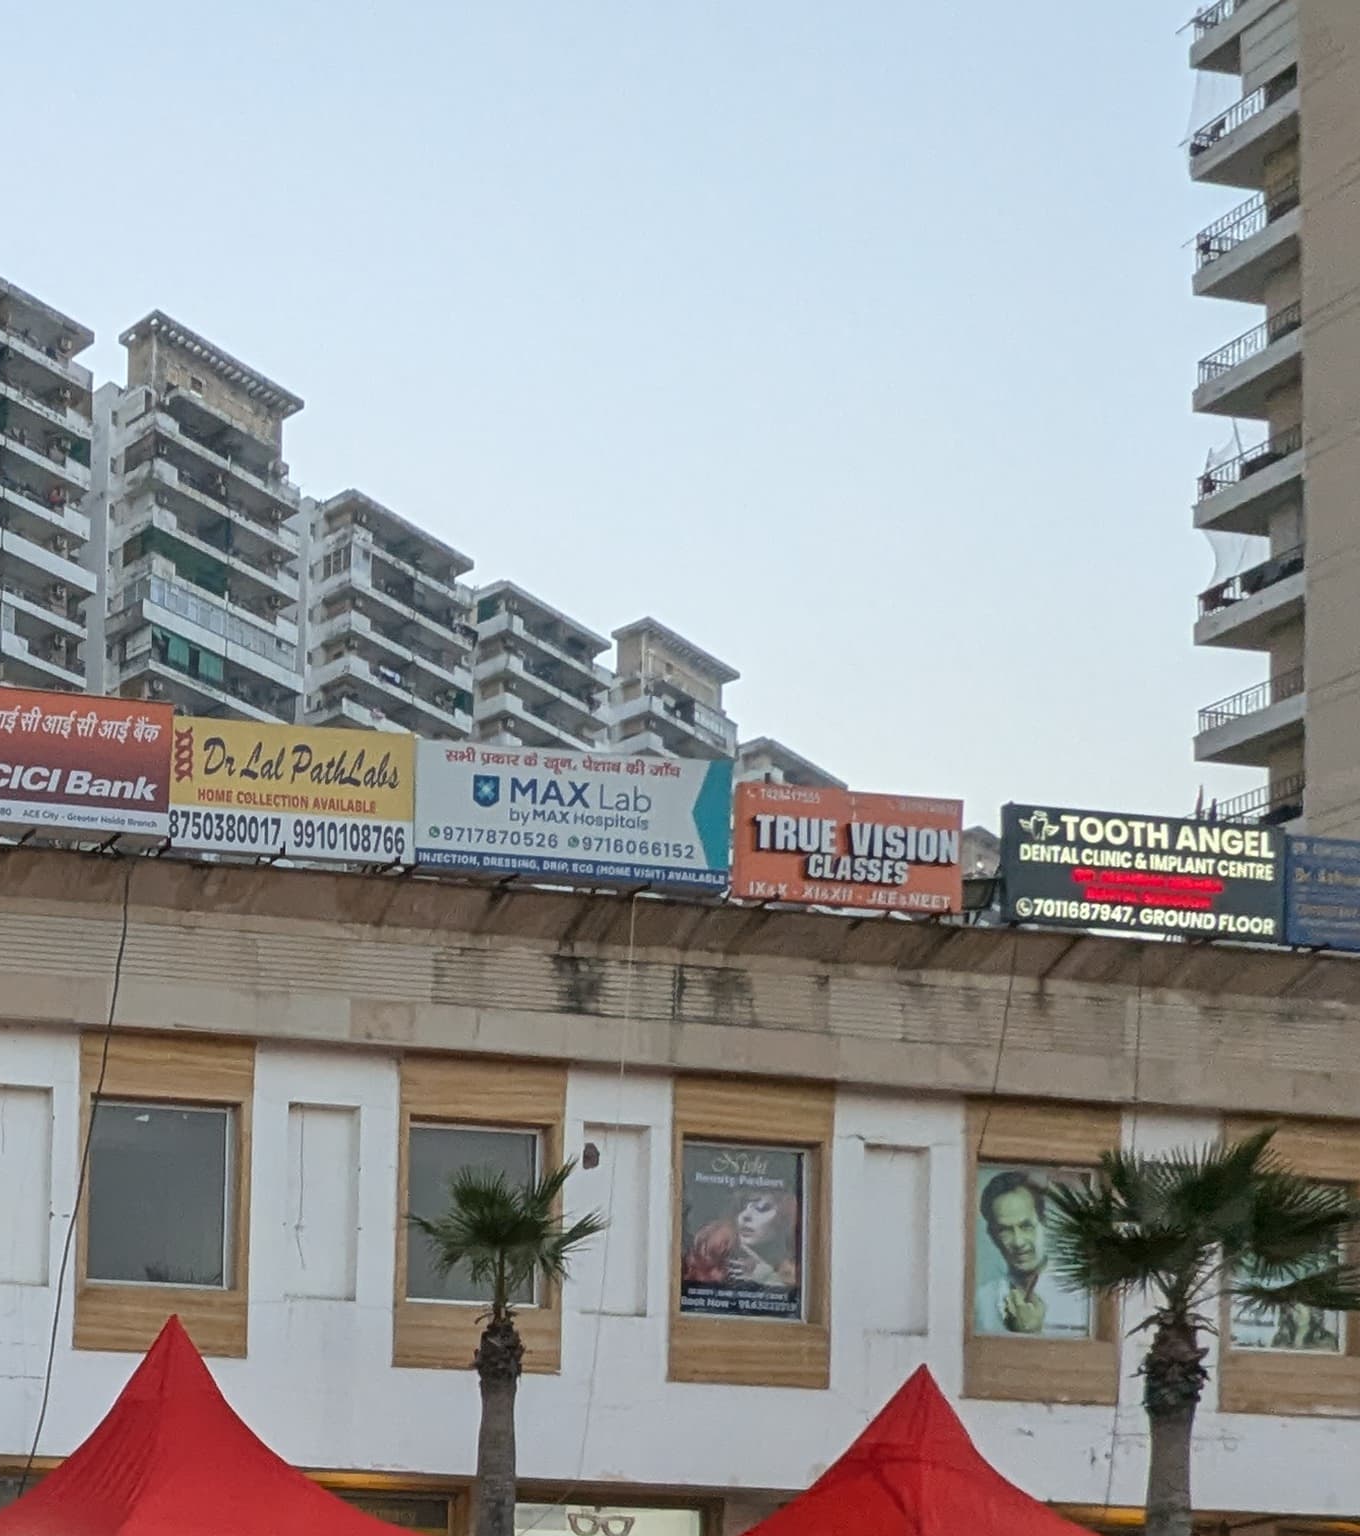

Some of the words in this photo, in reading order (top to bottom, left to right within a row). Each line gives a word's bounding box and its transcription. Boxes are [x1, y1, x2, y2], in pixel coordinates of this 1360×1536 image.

[21, 706, 41, 732] सी
[42, 711, 77, 739] आई
[77, 711, 96, 737] सी
[98, 717, 132, 743] आई
[133, 716, 162, 743] बैंक
[203, 737, 236, 777] Dr
[240, 741, 286, 780] Lal
[290, 744, 400, 790] PathLabs
[445, 747, 476, 762] सभी
[481, 753, 520, 765] प्रकार
[65, 770, 158, 801] Bank
[198, 788, 233, 801] HOME
[236, 791, 309, 808] COLLECTION
[313, 797, 376, 814] AVAILABLE
[510, 777, 590, 809] MAX
[600, 784, 651, 813] Lab
[23, 809, 40, 818] ACE
[42, 810, 59, 821] City
[67, 813, 99, 823] Greater
[100, 816, 125, 826] Noida
[509, 808, 530, 826] by
[533, 808, 569, 824] MAX
[574, 811, 649, 831] Hospitals
[293, 819, 405, 854] 9910108766
[443, 826, 558, 848] 9717870526
[755, 814, 837, 854] TRUE
[851, 822, 959, 864] VISION
[1060, 815, 1169, 850] TOOTH
[1176, 825, 1274, 858] ANGEL
[418, 852, 480, 867] INJECTION,
[483, 856, 540, 871] DRESSING,
[668, 870, 725, 884] AVAILABLE
[807, 854, 909, 885] CLASSES
[1020, 844, 1079, 865] DENTAL
[1082, 848, 1132, 867] CLINIC
[1136, 853, 1147, 870] &
[1150, 855, 1214, 875] IMPLANT
[1217, 860, 1274, 881] CENTRE
[1032, 898, 1136, 926] 7011687947,
[1139, 908, 1216, 930] GROUND
[1219, 915, 1274, 934] FLOOR
